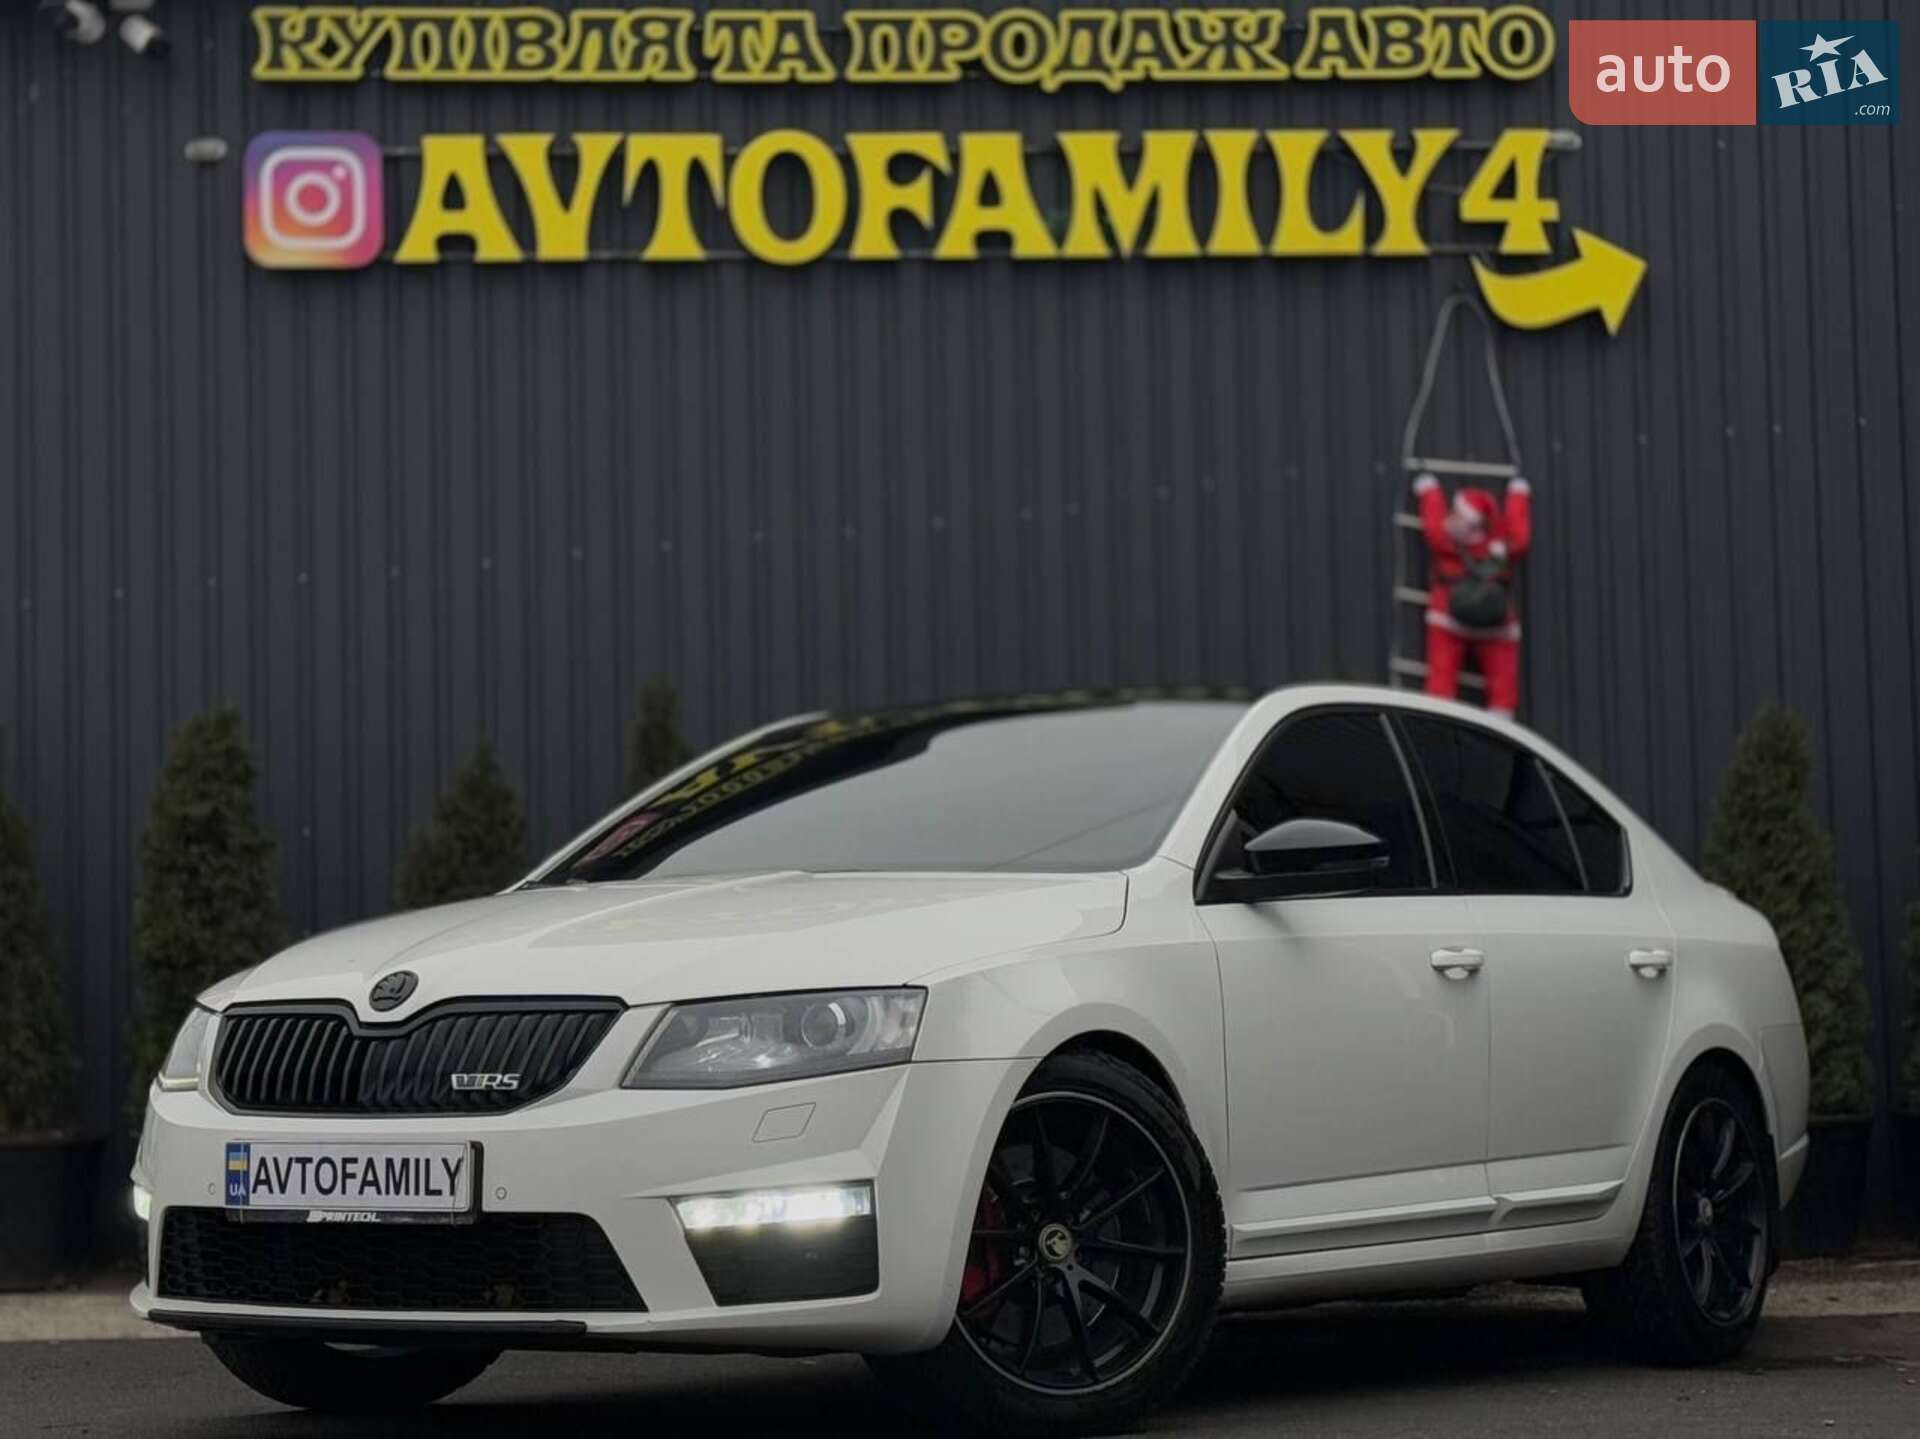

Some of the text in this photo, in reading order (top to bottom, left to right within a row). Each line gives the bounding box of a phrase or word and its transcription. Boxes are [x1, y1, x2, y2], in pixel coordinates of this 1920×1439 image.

[252, 5, 1555, 92] КУПІВЛЯ ТА ПРОДАЖ АВТО
[229, 1156, 463, 1197] UA AVTOFAMILY
